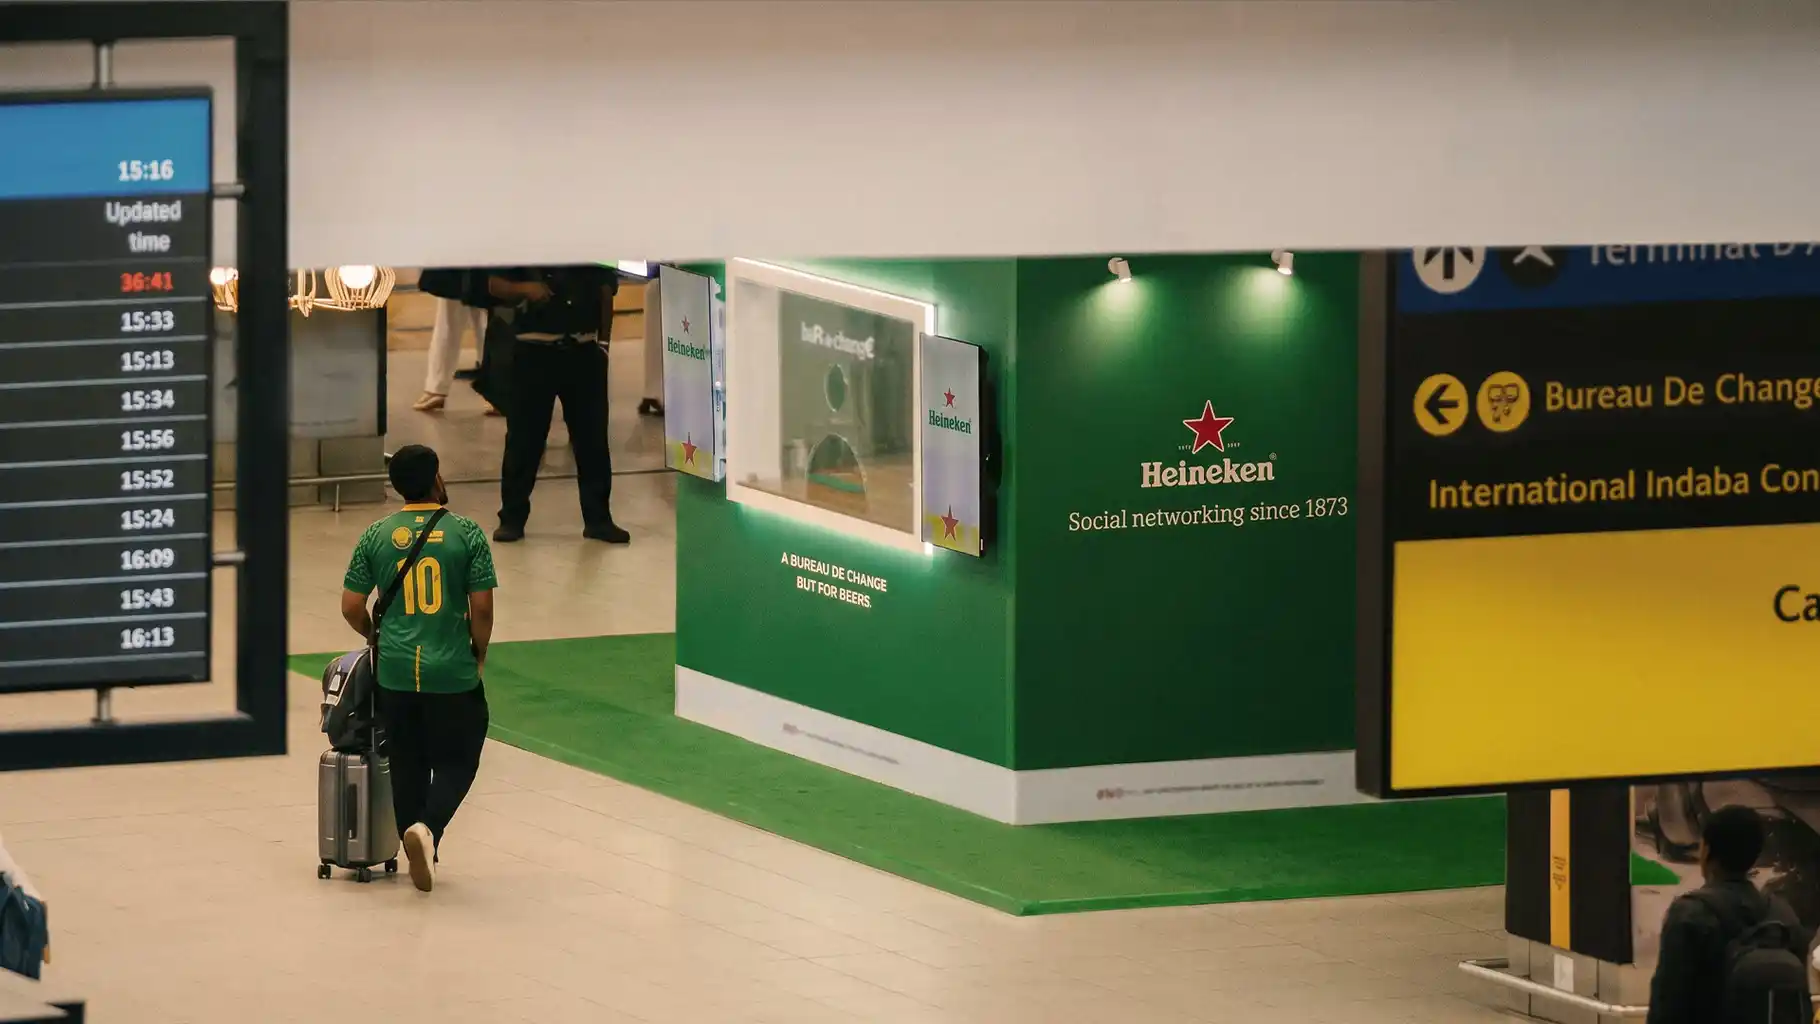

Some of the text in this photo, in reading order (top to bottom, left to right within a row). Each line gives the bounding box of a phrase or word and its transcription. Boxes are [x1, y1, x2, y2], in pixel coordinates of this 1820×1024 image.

[117, 159, 174, 181] 15:16
[105, 200, 182, 226] Updated
[127, 231, 171, 252] time
[120, 310, 175, 332] 15:33
[667, 336, 706, 361] Heineken
[120, 350, 175, 372] 15:13
[120, 389, 175, 411] 15:34
[1545, 380, 1652, 412] Bureau
[1663, 375, 1705, 407] De
[928, 409, 972, 435] Heineken
[120, 429, 175, 451] 15:56
[120, 469, 175, 491] 15:52
[1140, 457, 1275, 488] Heineken
[1429, 470, 1635, 508] International
[1646, 465, 1750, 498] Indaba
[120, 508, 175, 530] 15:24
[1068, 497, 1348, 531] Social networking since 1873
[120, 548, 175, 570] 16:09
[781, 552, 887, 592] A BUREAU DE CHANGE
[396, 557, 443, 615] 10
[796, 575, 872, 609] BUT FOR BEERS.
[120, 588, 175, 610] 15:43
[1773, 583, 1820, 624] Ca
[120, 627, 175, 649] 16:13
